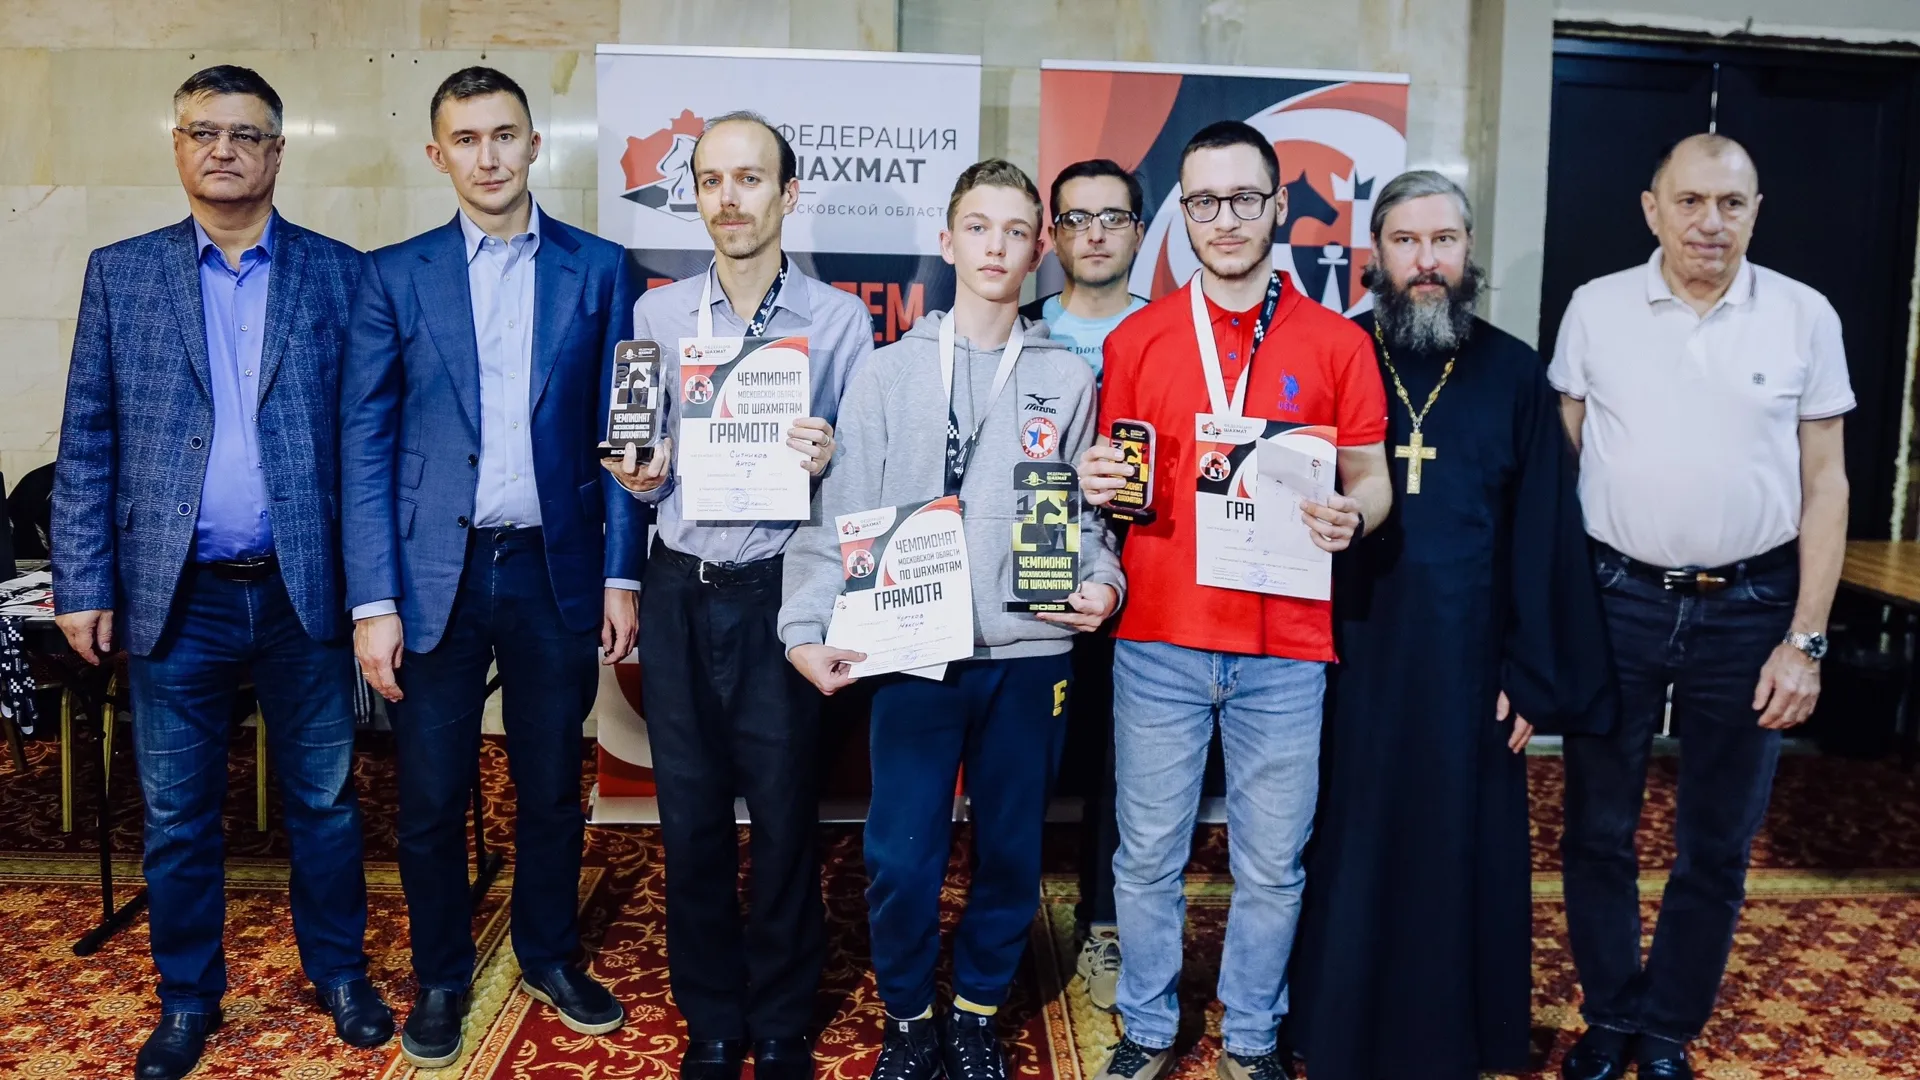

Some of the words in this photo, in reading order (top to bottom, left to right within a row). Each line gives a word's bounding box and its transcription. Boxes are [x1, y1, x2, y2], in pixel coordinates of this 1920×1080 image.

[775, 123, 957, 153] ФЕДЕРАЦИЯ
[796, 203, 879, 216] СКОВСКОЙ
[884, 205, 948, 218] ОБЛАСТ
[737, 371, 802, 387] ЧЕМПИОНАТ
[737, 403, 749, 415] ПО
[751, 402, 803, 415] ШАХМАТАМ
[709, 422, 779, 443] ГРАМОТА
[895, 530, 957, 554] ЧЕМПИОНАТ
[899, 569, 911, 581] ПО
[913, 561, 963, 579] ШАХМАТАМ
[1018, 556, 1073, 569] ЧЕМПИОНАТ
[1018, 579, 1029, 590] ПО
[1029, 579, 1073, 590] ШАХМАТАМ
[874, 581, 943, 612] ГРАМОТА
